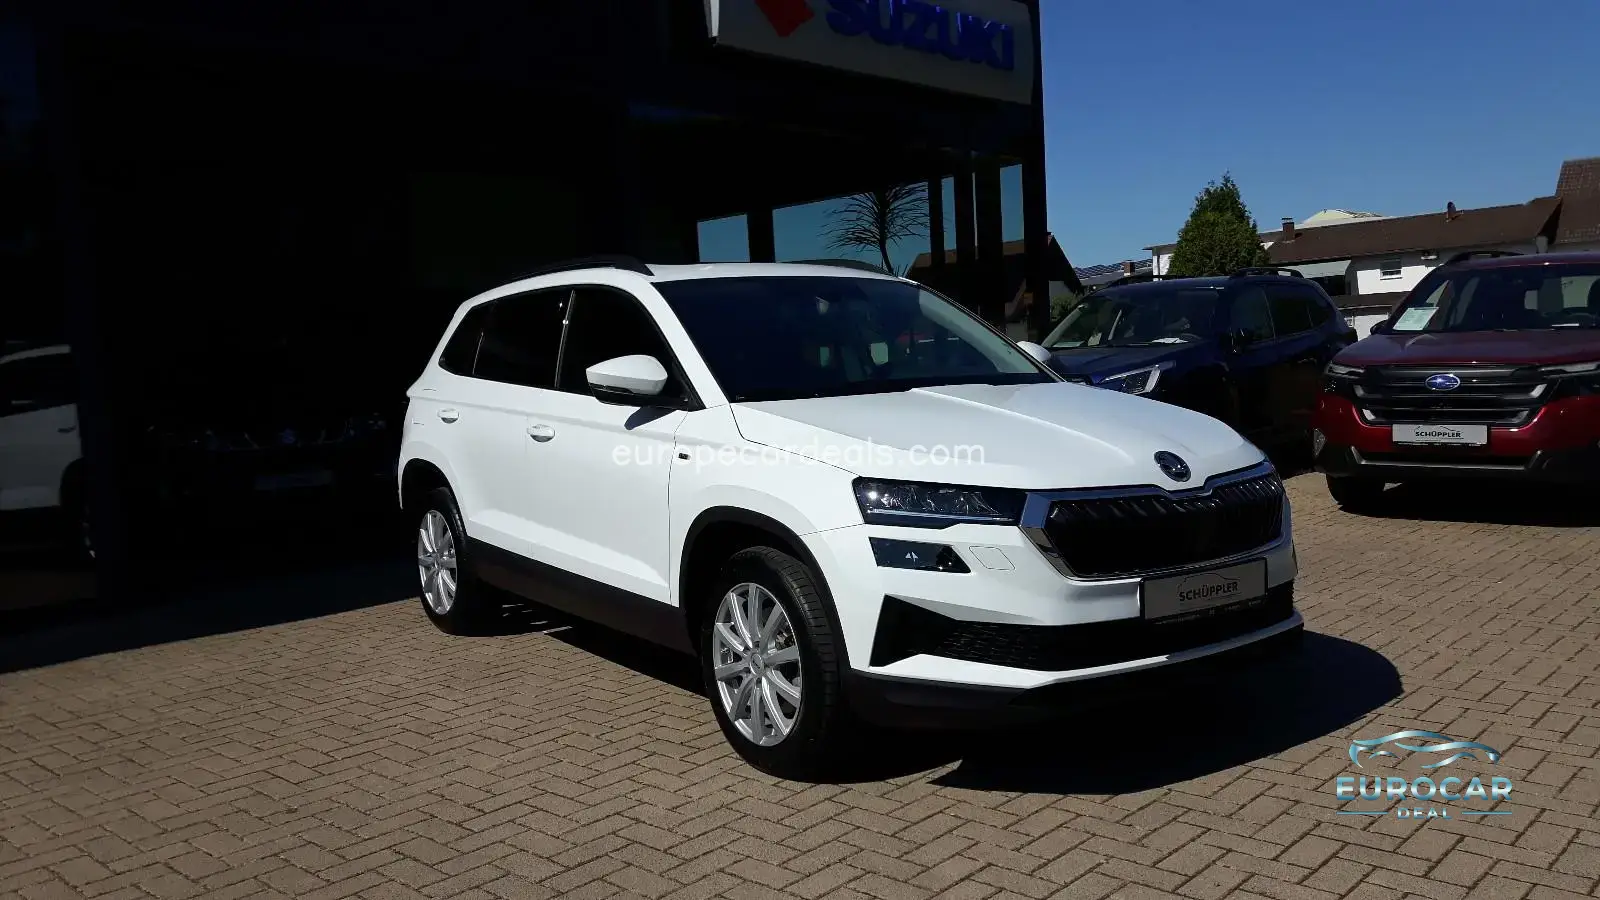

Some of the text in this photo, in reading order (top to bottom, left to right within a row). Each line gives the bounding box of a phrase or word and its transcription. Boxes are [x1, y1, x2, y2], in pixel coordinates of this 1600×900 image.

[826, 0, 1014, 70] SUZUKI
[1415, 430, 1462, 438] SCHÜPPLER
[1179, 581, 1239, 602] SCHÜPPLER
